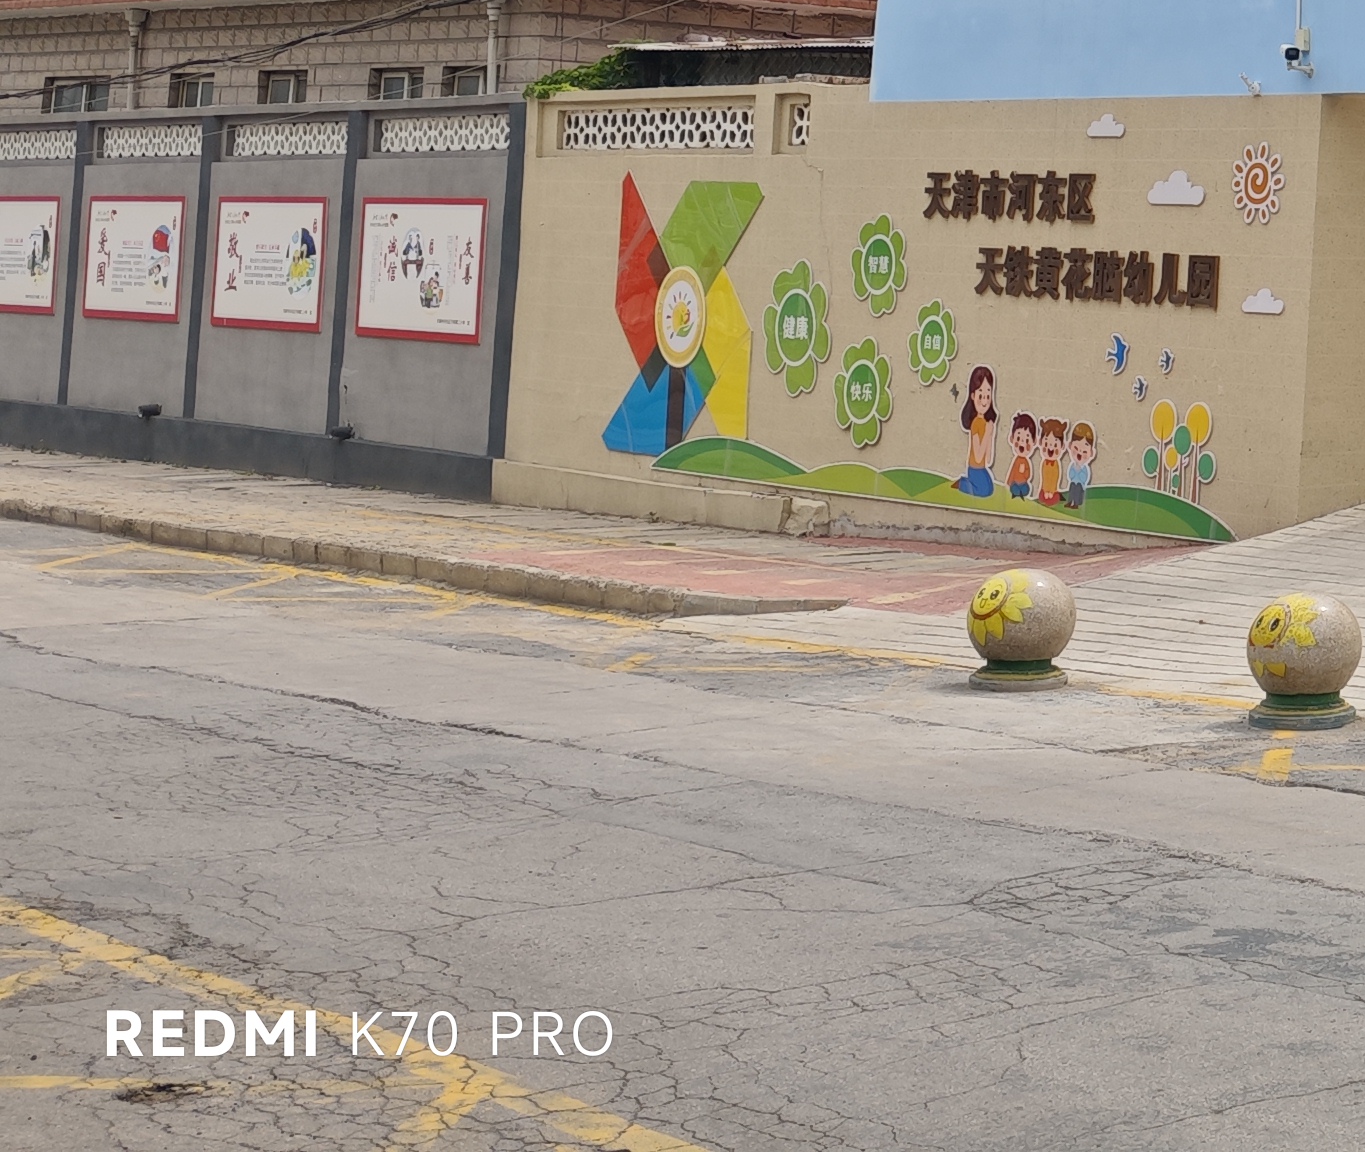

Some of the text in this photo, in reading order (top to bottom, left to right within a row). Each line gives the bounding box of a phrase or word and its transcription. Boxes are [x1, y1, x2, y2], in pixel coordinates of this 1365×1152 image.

[923, 170, 1097, 224] 天津市河东区
[868, 255, 890, 275] 智慧
[974, 246, 1220, 312] 天铁黄花脑幼儿园
[782, 315, 809, 340] 健康
[923, 334, 941, 351] 自信
[850, 381, 873, 402] 快乐
